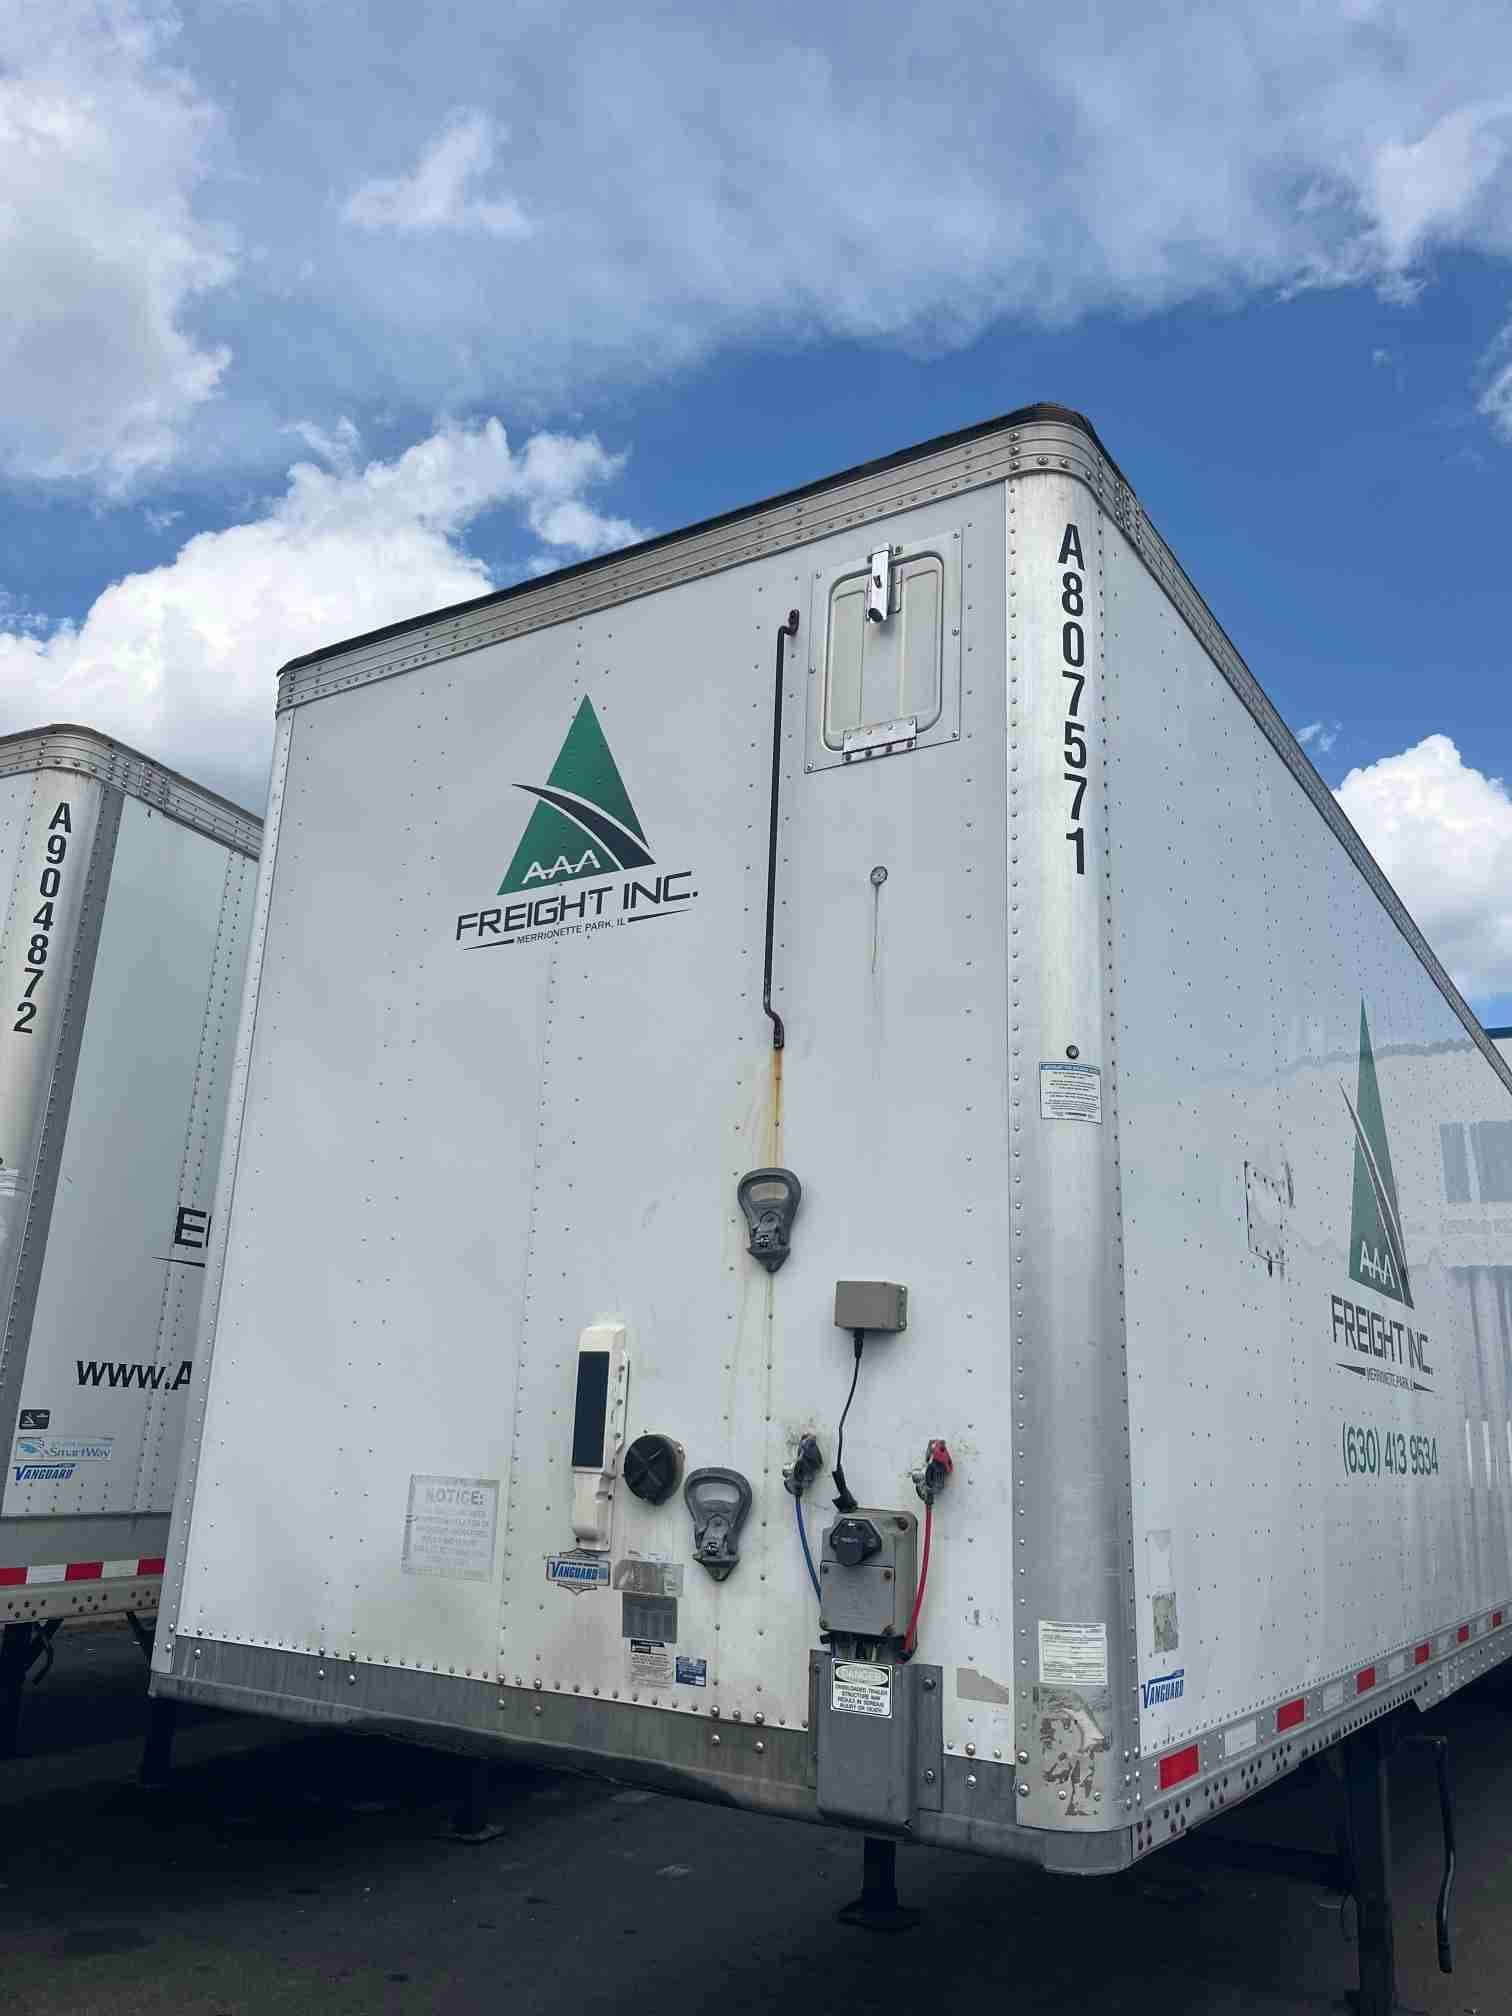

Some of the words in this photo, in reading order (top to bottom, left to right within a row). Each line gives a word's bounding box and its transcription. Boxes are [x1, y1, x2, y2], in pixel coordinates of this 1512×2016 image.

[1058, 523, 1087, 875] A807571
[521, 849, 601, 884] AAA
[13, 801, 72, 1034] A904872
[456, 886, 613, 940] FREIGHT
[623, 871, 699, 910] INC.
[516, 925, 583, 945] MERRIONETTE
[1359, 1240, 1396, 1289] AAA
[1331, 1294, 1405, 1364] FREIGHT
[1342, 1421, 1381, 1479] (630)
[1384, 1431, 1407, 1475] 413
[1409, 1434, 1439, 1476] 9534
[550, 1561, 599, 1580] VANGUARD
[1141, 1674, 1184, 1709] VANGUARD
